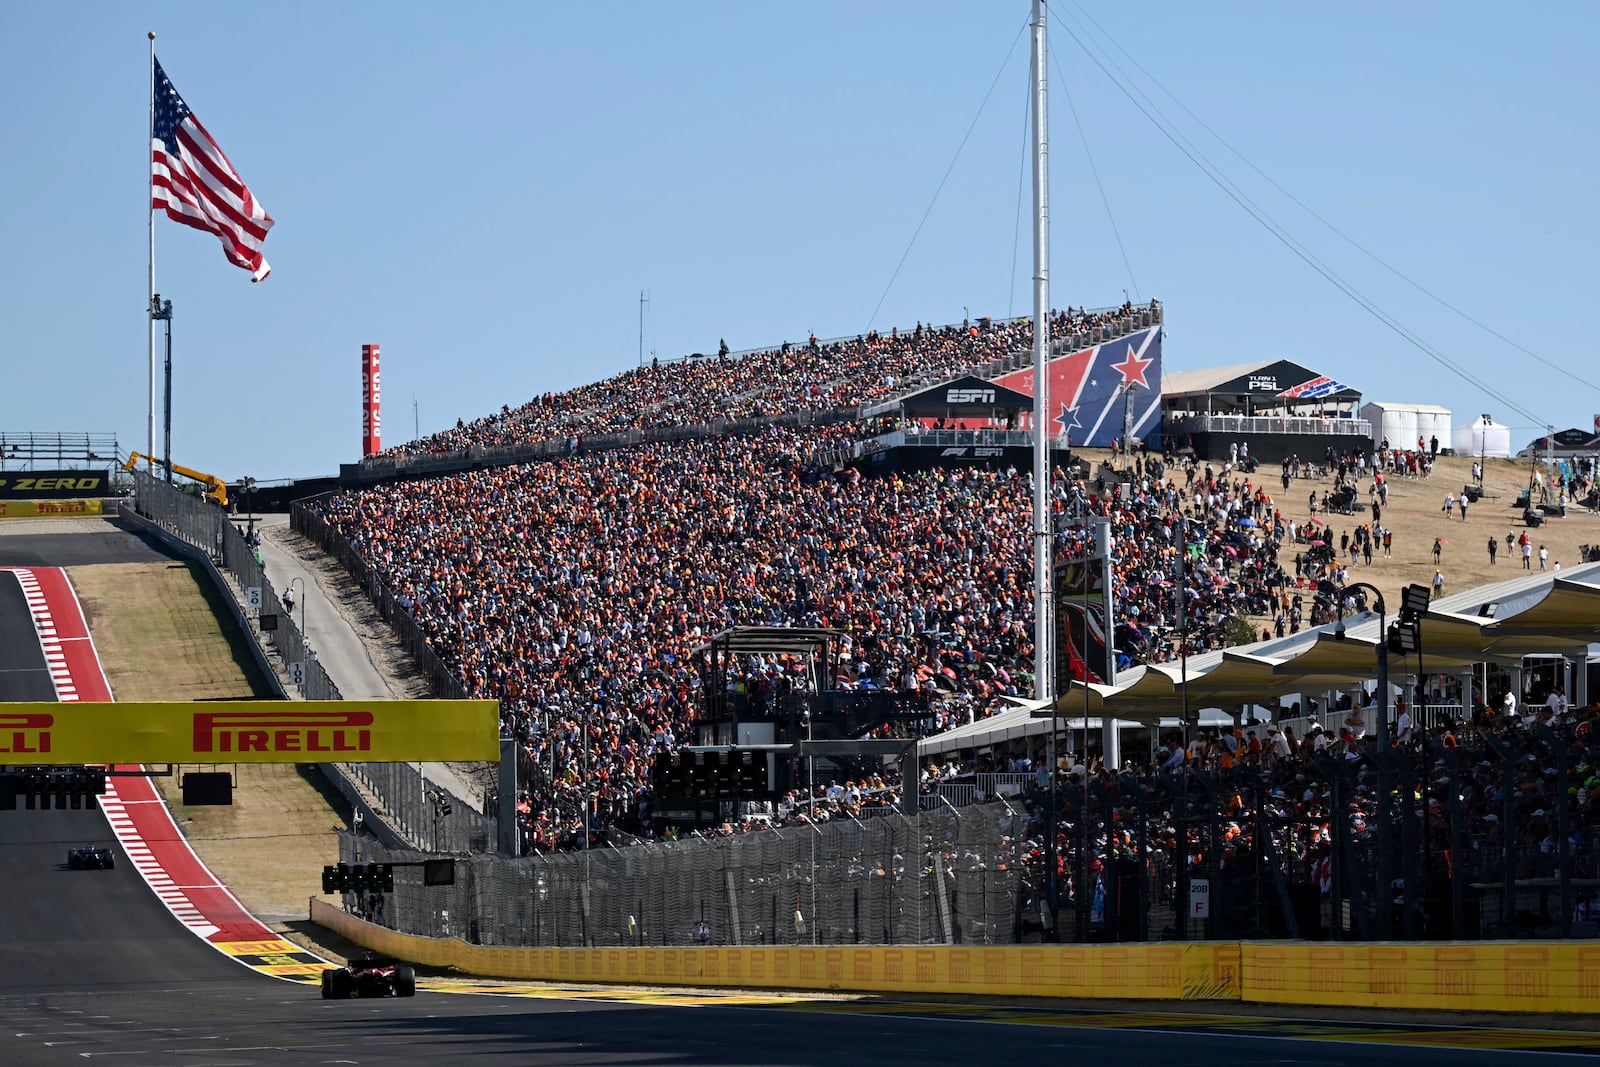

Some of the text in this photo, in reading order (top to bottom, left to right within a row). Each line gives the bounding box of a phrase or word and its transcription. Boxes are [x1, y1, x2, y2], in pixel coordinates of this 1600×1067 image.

[1249, 381, 1283, 391] PSL
[946, 389, 995, 403] ESPN
[974, 448, 1004, 457] ESPN
[12, 478, 100, 490] ZERO
[38, 501, 86, 513] PIRELLI
[251, 590, 259, 605] 50
[193, 712, 374, 752] PIRELLI
[1195, 902, 1204, 913] F
